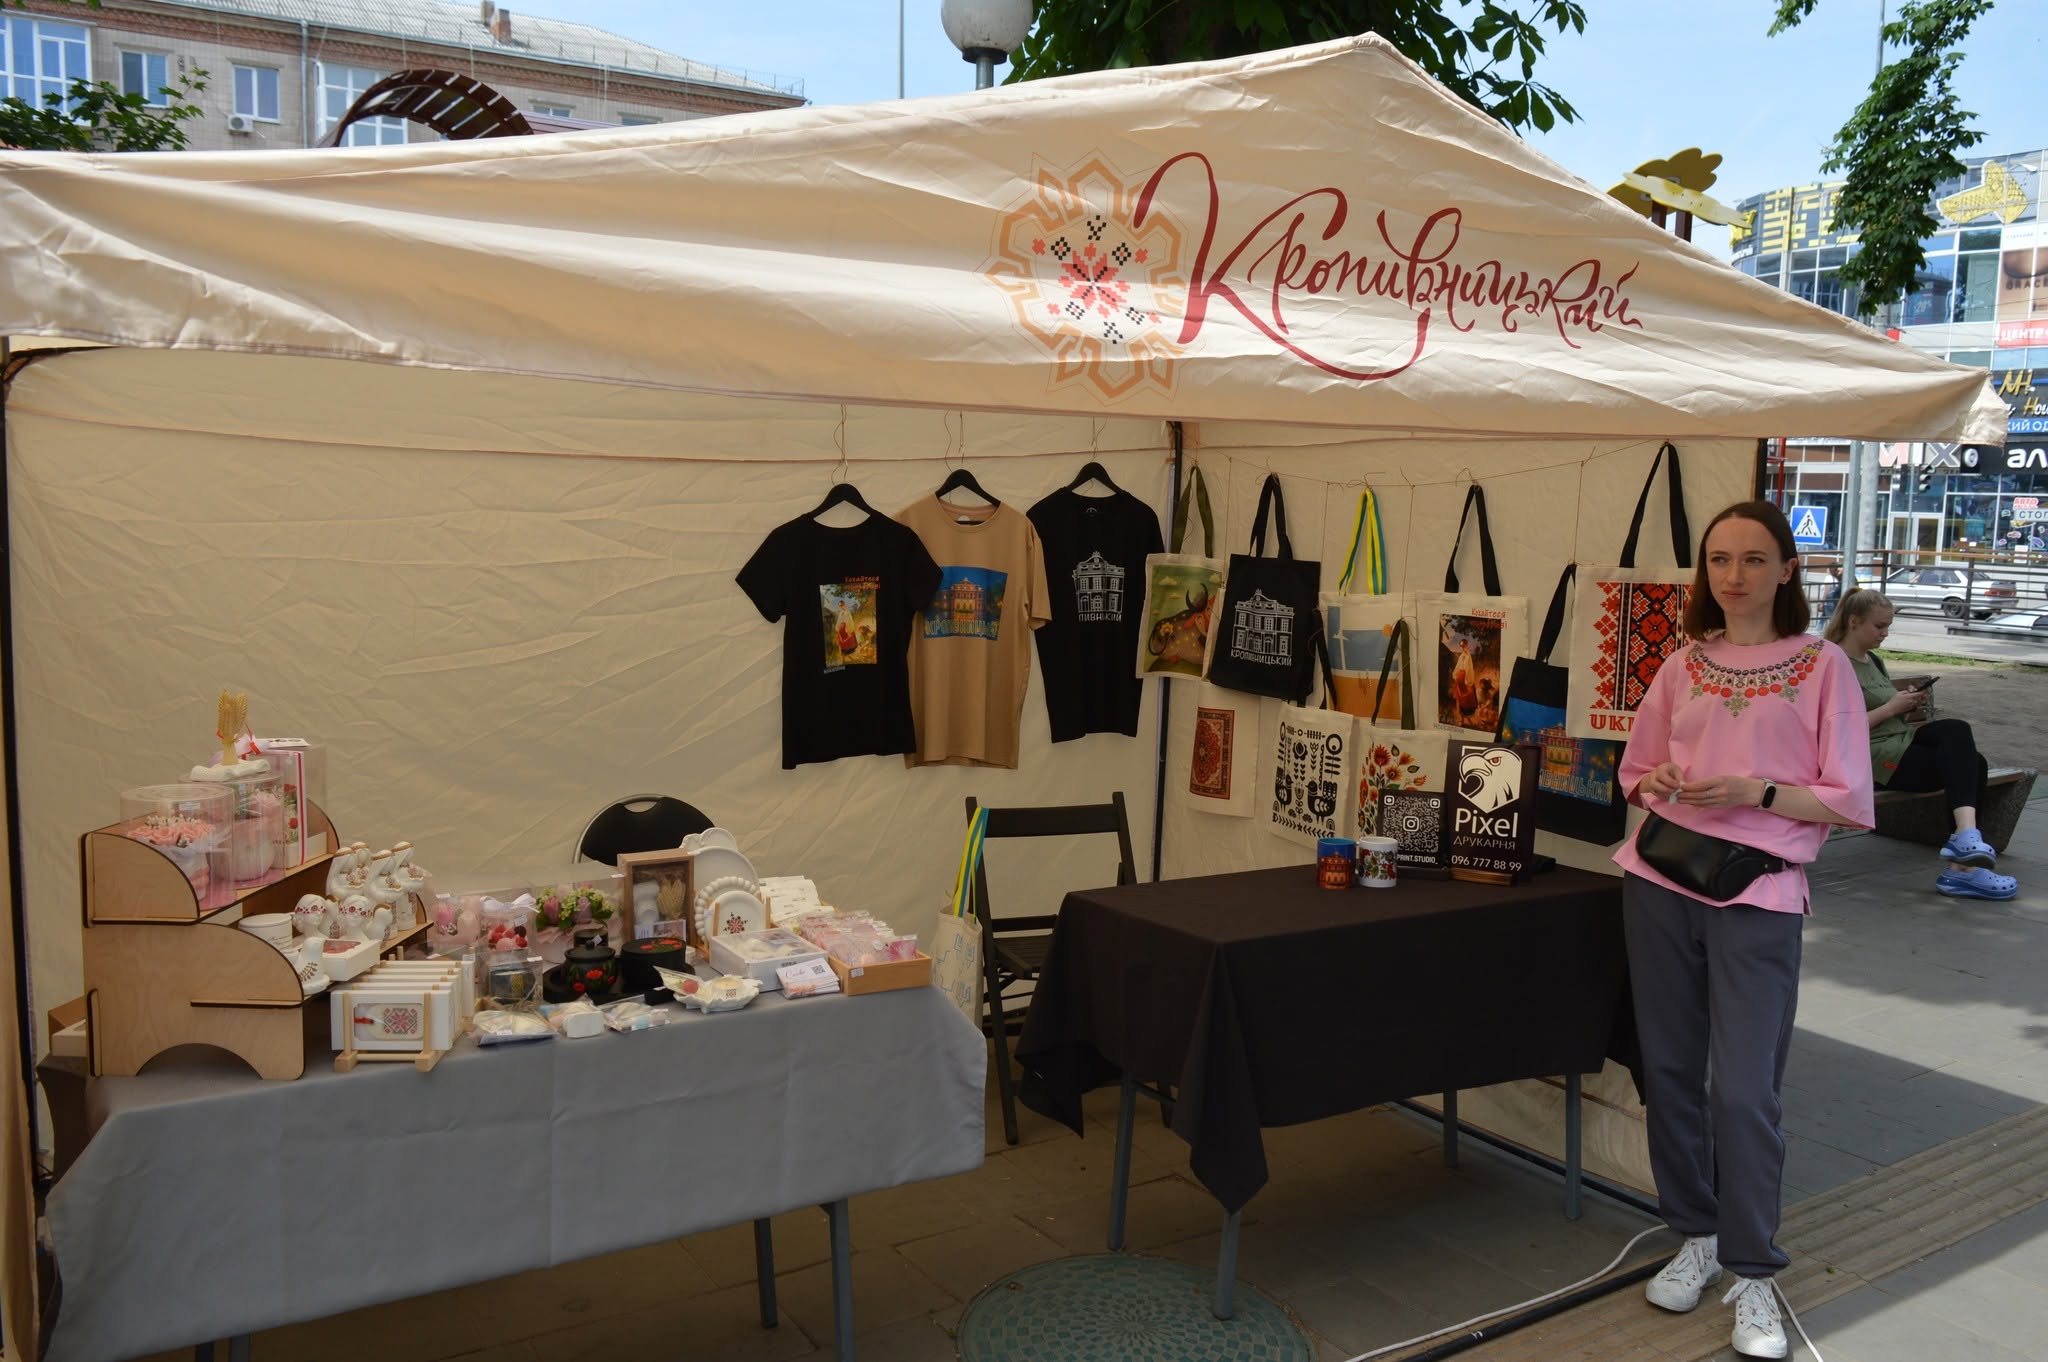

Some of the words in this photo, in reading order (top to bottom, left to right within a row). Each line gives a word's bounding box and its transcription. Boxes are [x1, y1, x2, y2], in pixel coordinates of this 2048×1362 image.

[1132, 151, 1643, 381] Кропивницький
[1455, 807, 1519, 839] Pixel
[1452, 835, 1516, 850] ДРУКАРНЯ
[1451, 855, 1470, 866] 096
[1473, 857, 1491, 868] 777
[1493, 859, 1506, 870] 88
[1509, 861, 1522, 872] 99
